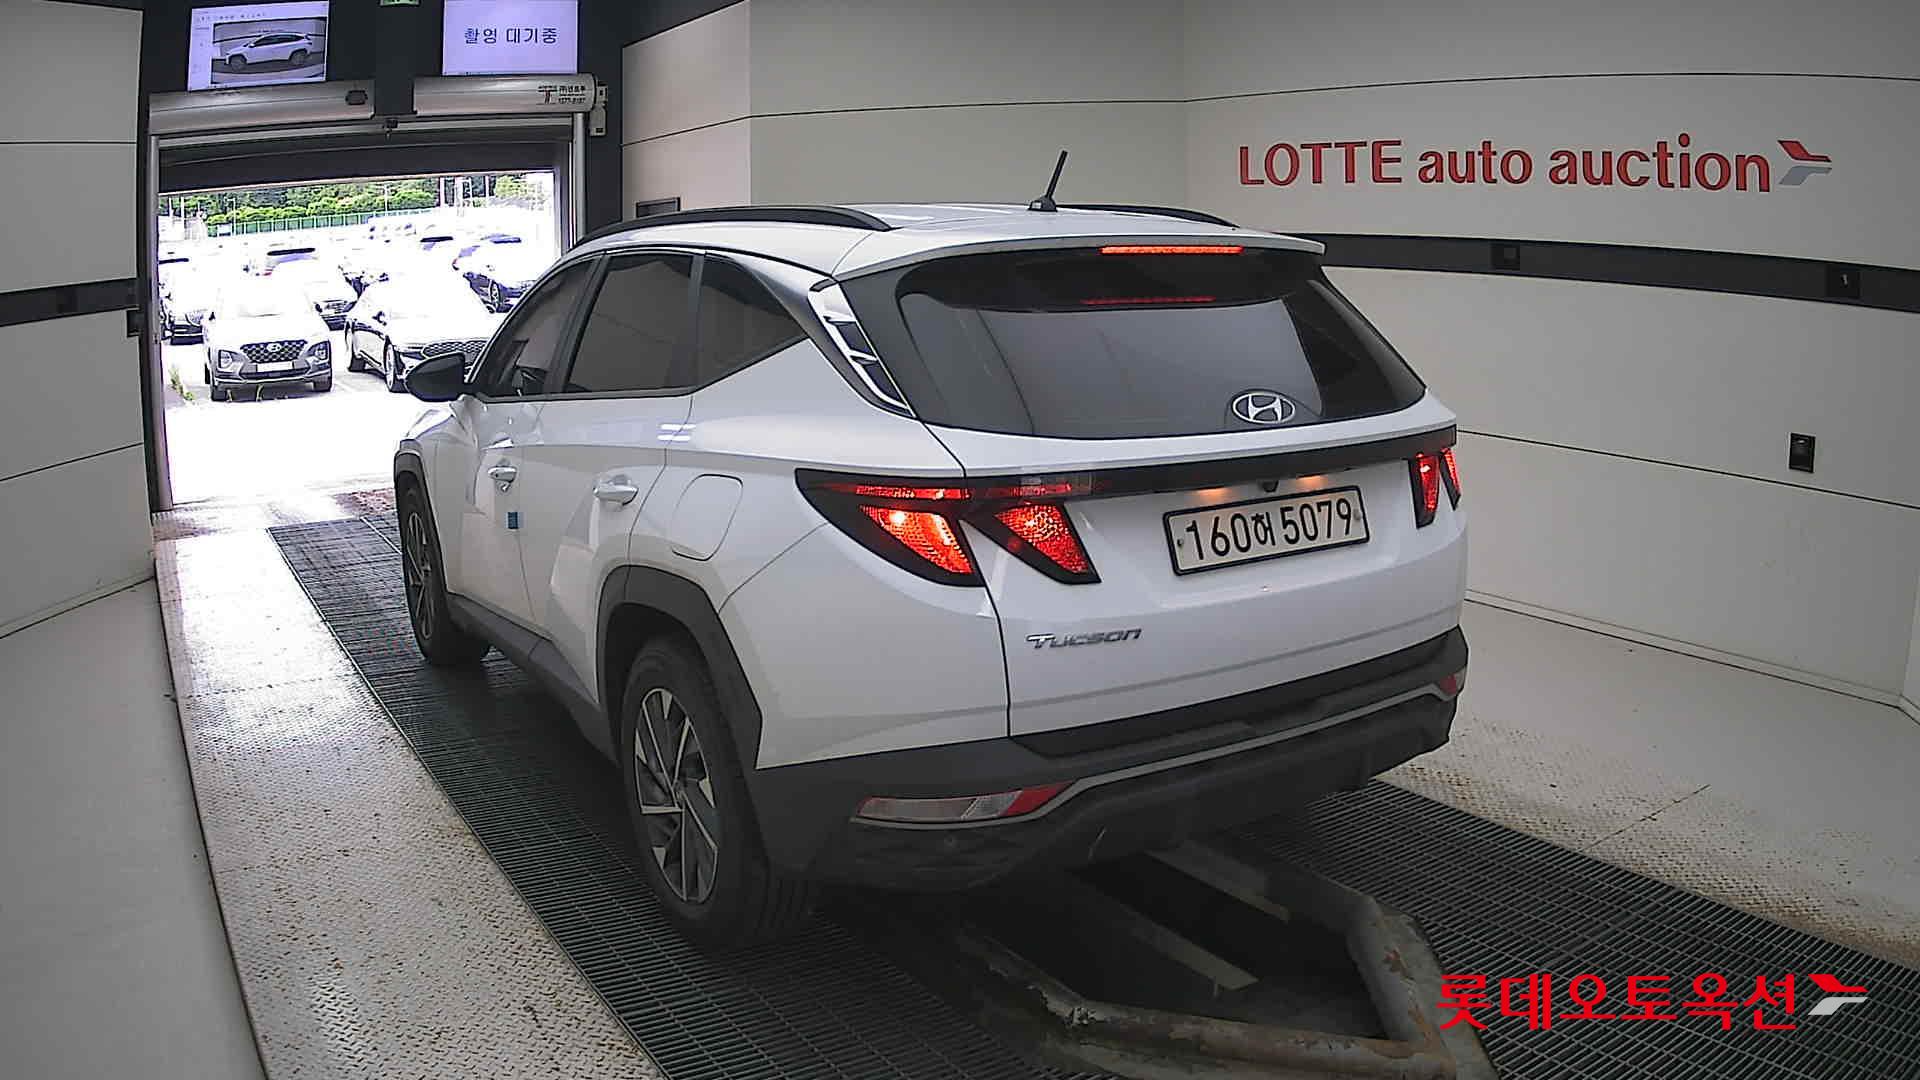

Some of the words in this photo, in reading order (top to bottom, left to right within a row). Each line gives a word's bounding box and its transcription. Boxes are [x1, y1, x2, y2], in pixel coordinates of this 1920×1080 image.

[505, 27, 559, 45] 대기중
[1238, 138, 1403, 187] LOTTE
[1416, 139, 1534, 186] auto
[1548, 132, 1771, 193] auction
[1185, 510, 1277, 561] 160허
[1279, 497, 1353, 545] 5079
